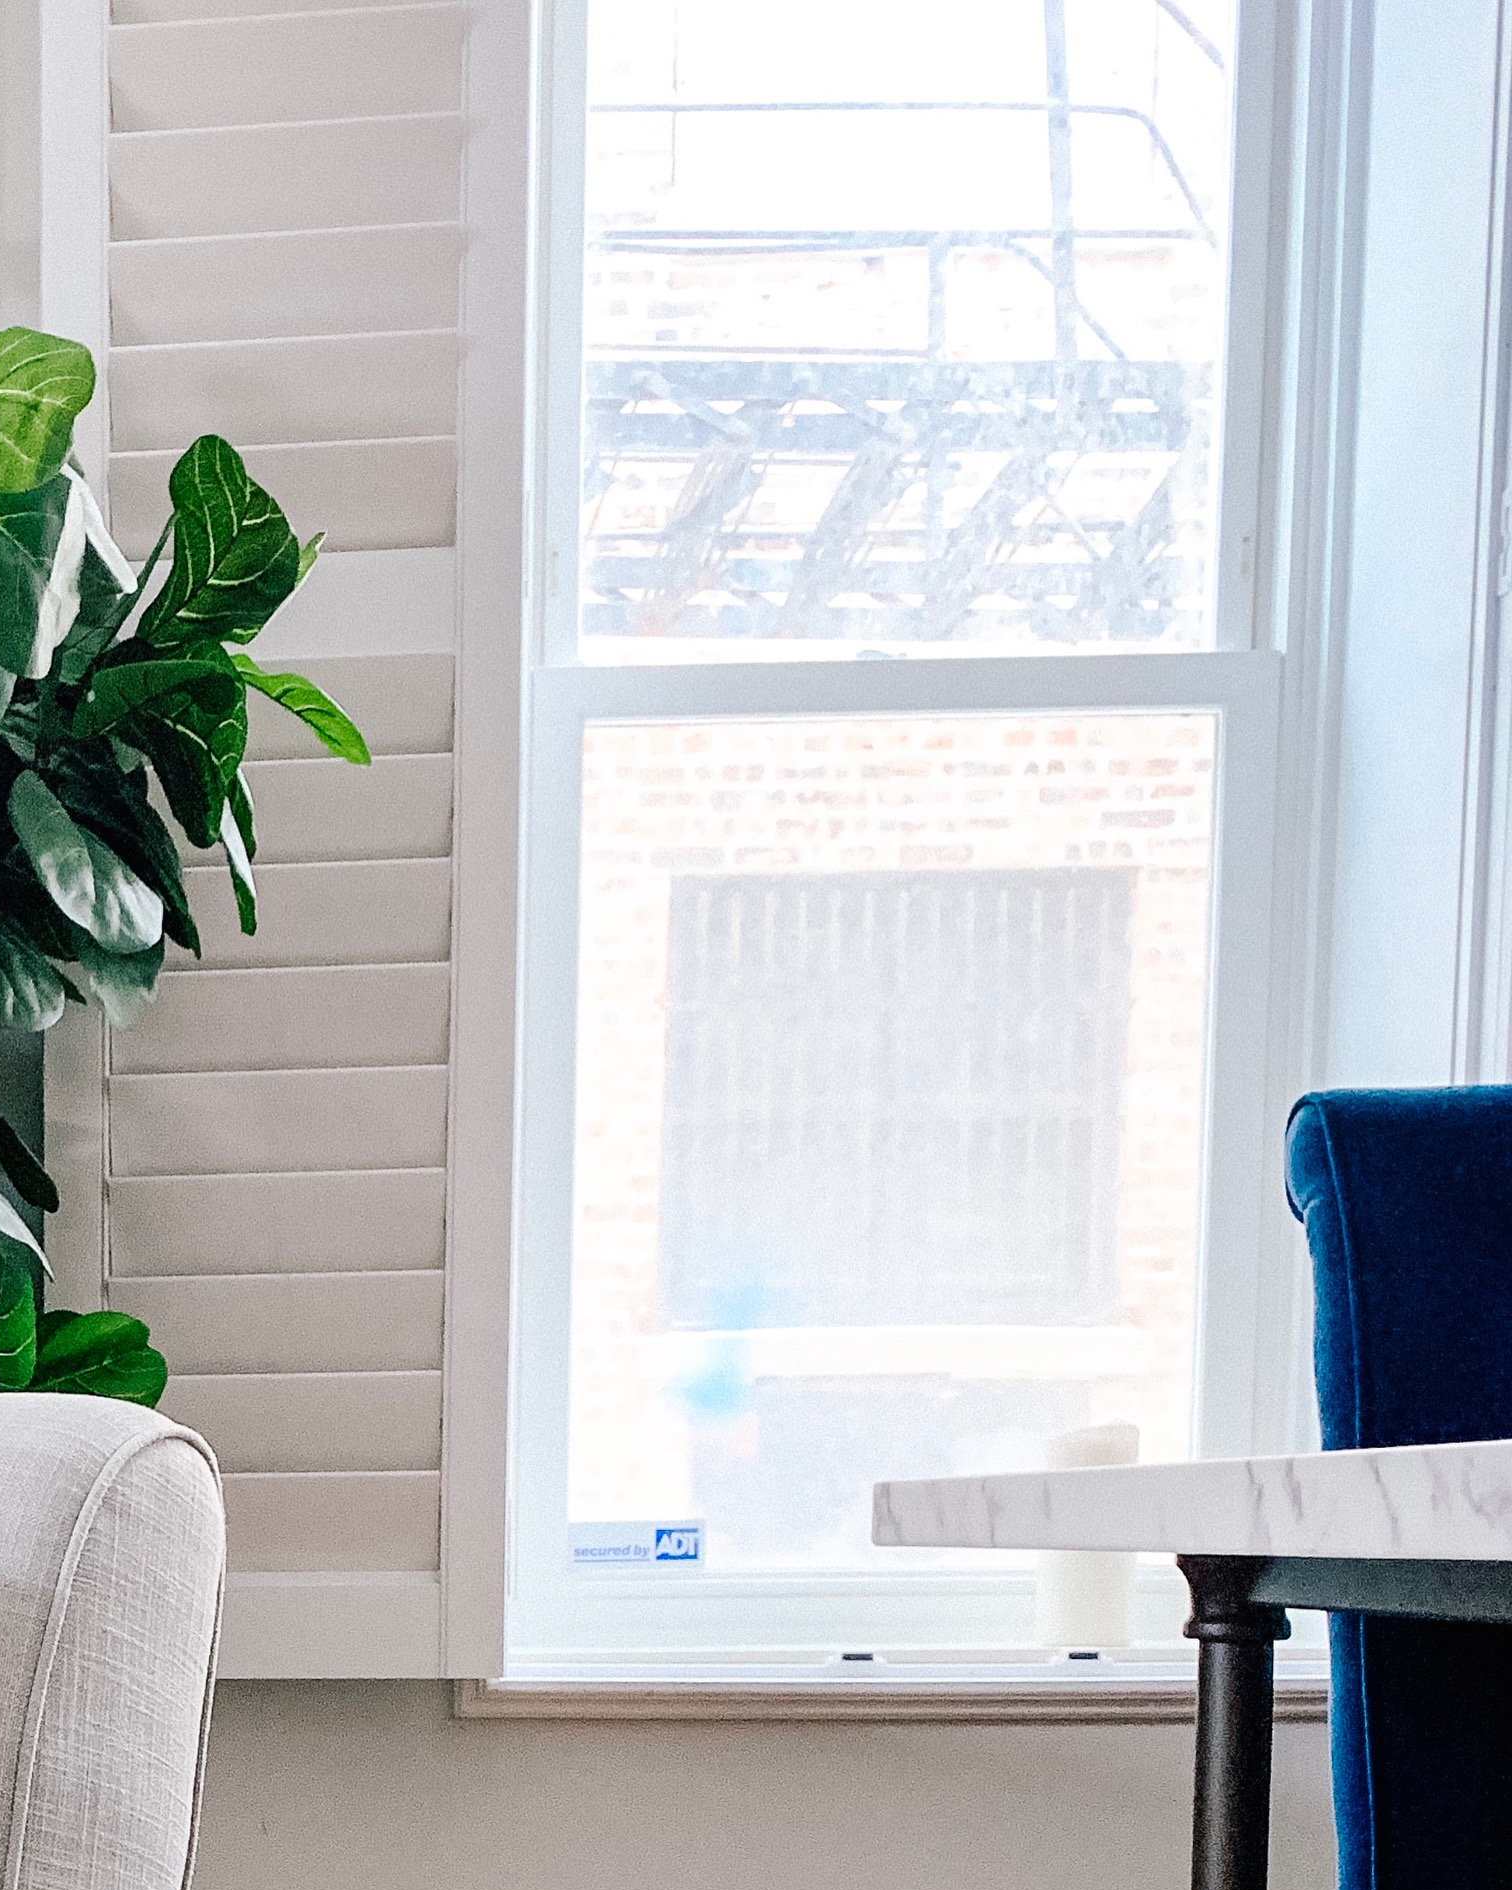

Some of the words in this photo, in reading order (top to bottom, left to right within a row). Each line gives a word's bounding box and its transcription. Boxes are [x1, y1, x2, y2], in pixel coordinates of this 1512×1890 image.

[574, 1545, 631, 1557] secured
[634, 1545, 650, 1557] by
[656, 1530, 698, 1557] ADT
